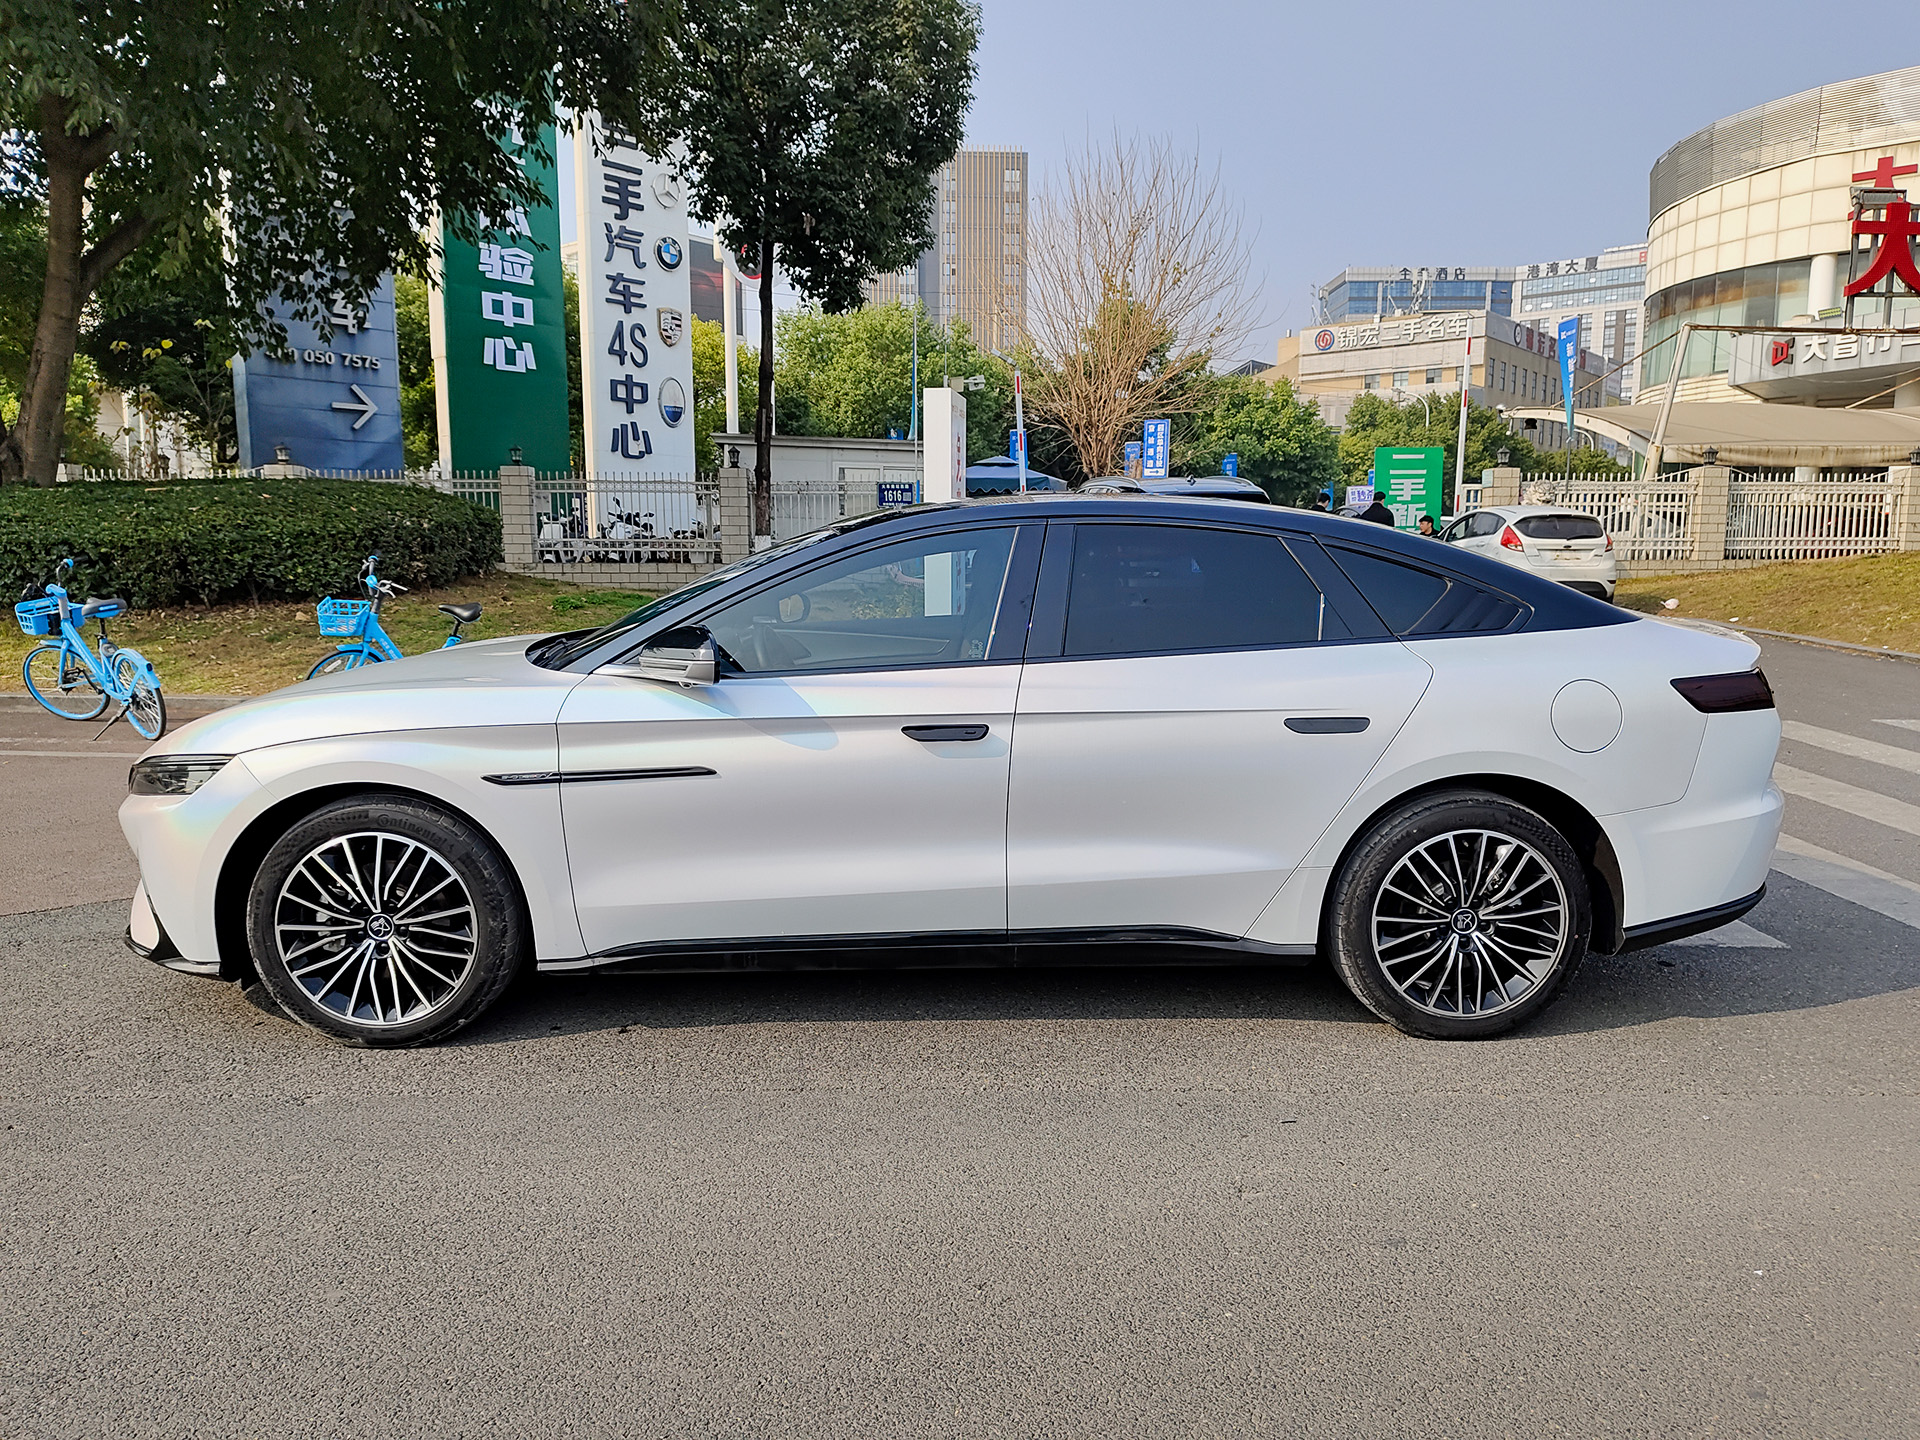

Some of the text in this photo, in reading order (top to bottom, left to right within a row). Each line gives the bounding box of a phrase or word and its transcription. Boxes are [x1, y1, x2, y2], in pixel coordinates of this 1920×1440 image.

[1527, 256, 1599, 279] 港湾大厦
[1337, 313, 1470, 349] 锦宏二手名车
[303, 349, 335, 365] 050
[341, 352, 381, 370] 7575
[884, 490, 902, 502] 1616
[1387, 454, 1427, 532] 二手新
